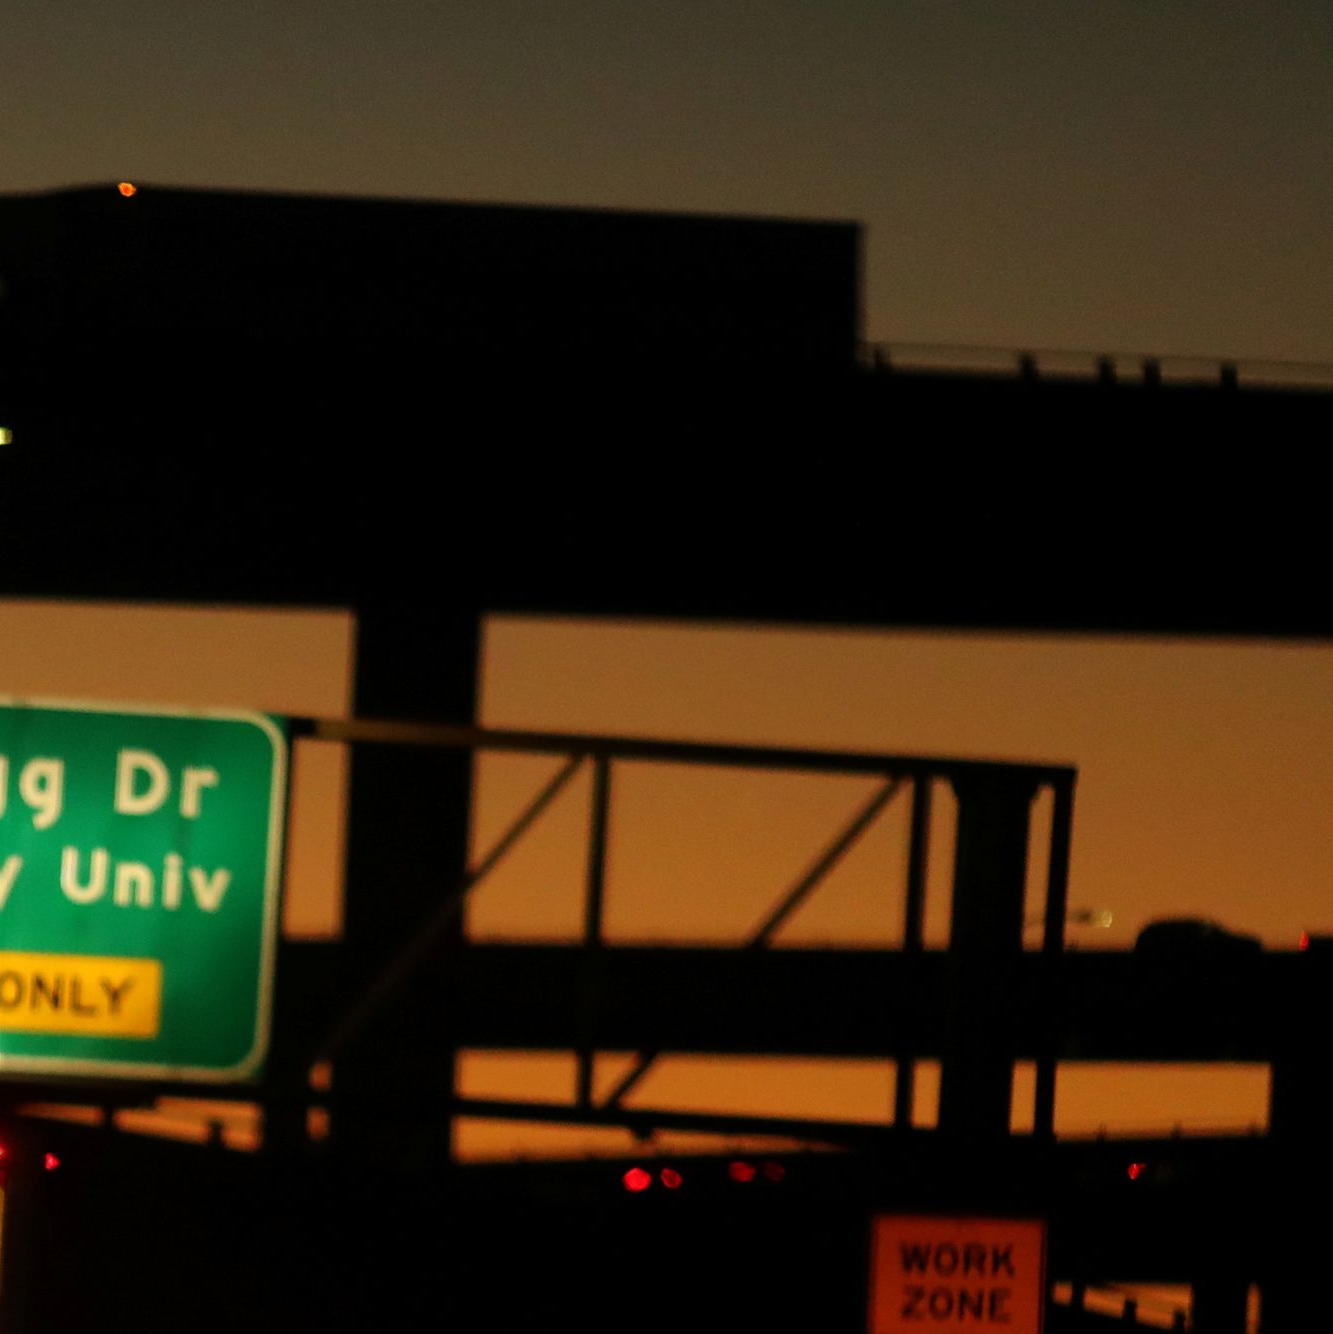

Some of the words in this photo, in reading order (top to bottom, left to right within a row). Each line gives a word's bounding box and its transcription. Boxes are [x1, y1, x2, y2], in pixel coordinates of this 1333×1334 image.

[113, 749, 220, 819] Dr
[60, 846, 231, 912] Univ
[899, 1241, 1015, 1279] WORK
[901, 1286, 1013, 1323] ZONE
